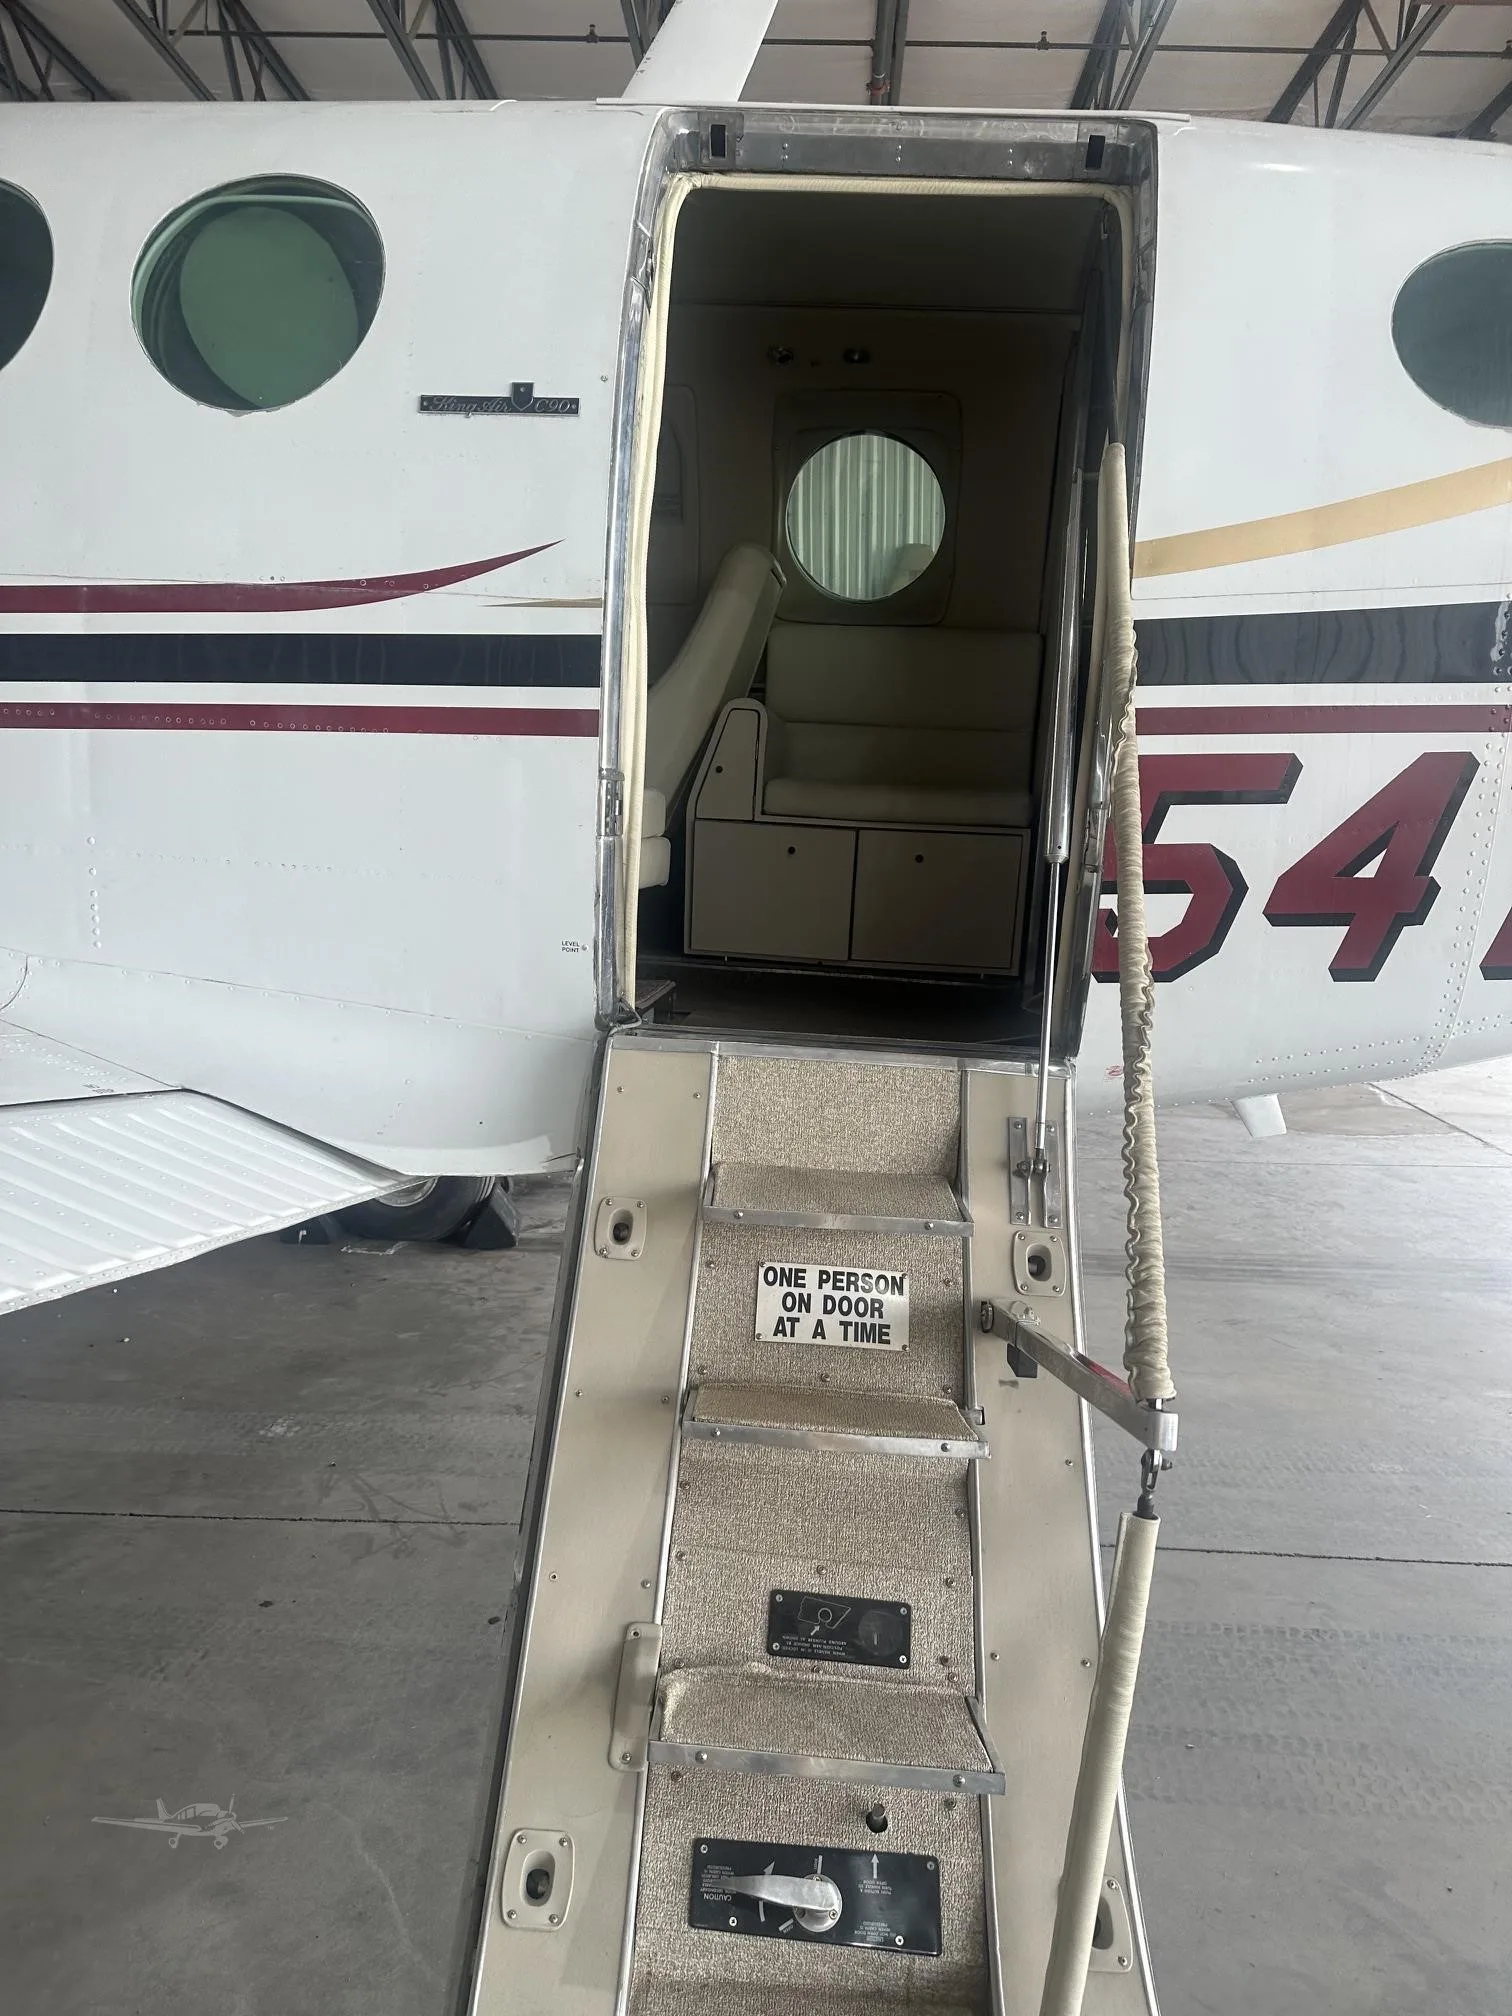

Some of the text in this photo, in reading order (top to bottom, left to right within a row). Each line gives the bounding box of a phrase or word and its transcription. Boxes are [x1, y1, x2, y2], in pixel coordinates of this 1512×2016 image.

[429, 396, 571, 413] King Air C90
[763, 1265, 904, 1296] ONE PERSON
[781, 1291, 884, 1319] ON DOOR
[772, 1316, 891, 1345] AT A TIME
[703, 1893, 732, 1901] CAUTION
